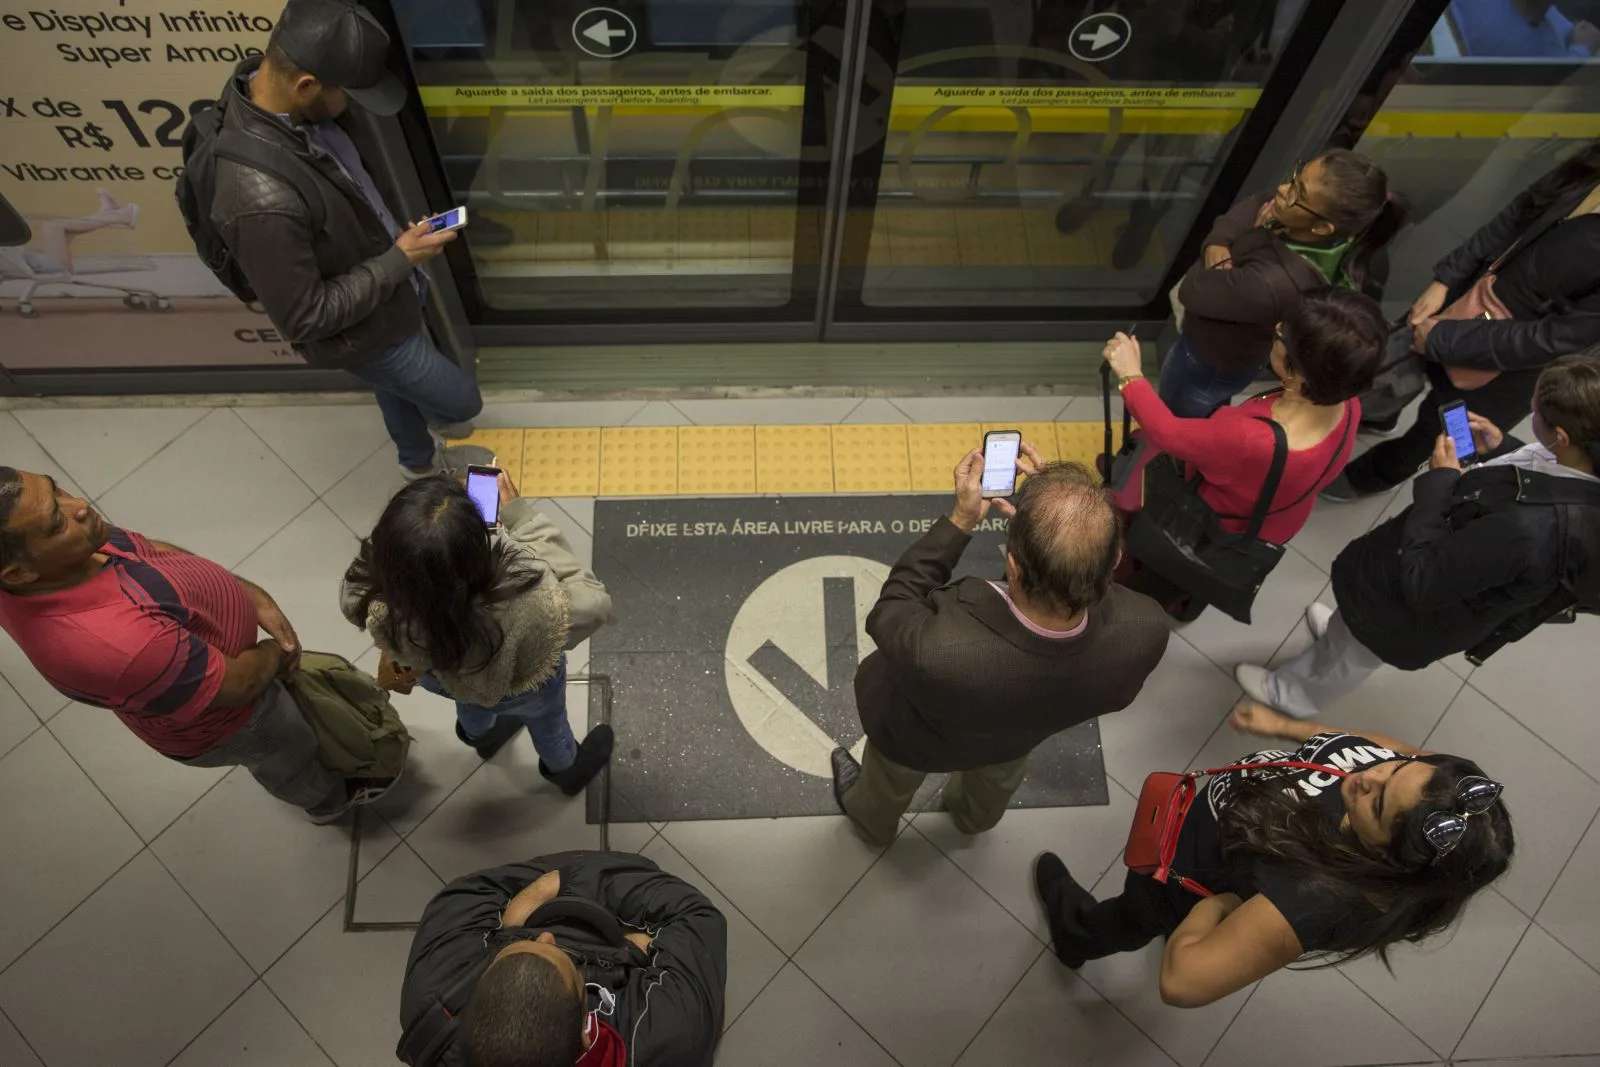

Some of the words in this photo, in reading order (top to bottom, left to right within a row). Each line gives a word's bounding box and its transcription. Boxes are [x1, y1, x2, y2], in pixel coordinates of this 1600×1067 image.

[2, 13, 26, 31] e
[28, 10, 152, 38] Display
[159, 10, 273, 33] Infinito
[56, 43, 152, 68] Super
[166, 43, 266, 63] Amole
[455, 87, 508, 98] Aguarde
[556, 87, 578, 96] dos
[582, 87, 655, 98] passageiros,
[659, 88, 692, 96] antes
[695, 87, 711, 96] de
[713, 87, 772, 96] embarcar.
[545, 97, 597, 105] passengers
[934, 87, 986, 98] Aguarde
[1033, 88, 1053, 97] dos
[1130, 89, 1163, 97] antes
[1165, 88, 1179, 98] de
[1018, 98, 1068, 106] passengers
[0, 97, 28, 118] x
[32, 97, 83, 118] de
[55, 121, 114, 151] R$
[101, 98, 220, 148] 12
[1, 162, 145, 181] Vibrante
[683, 520, 727, 536] ESTA
[731, 517, 780, 535] ÁREA
[784, 520, 835, 535] LIVRE
[837, 520, 887, 534] PARA
[891, 519, 904, 533] O
